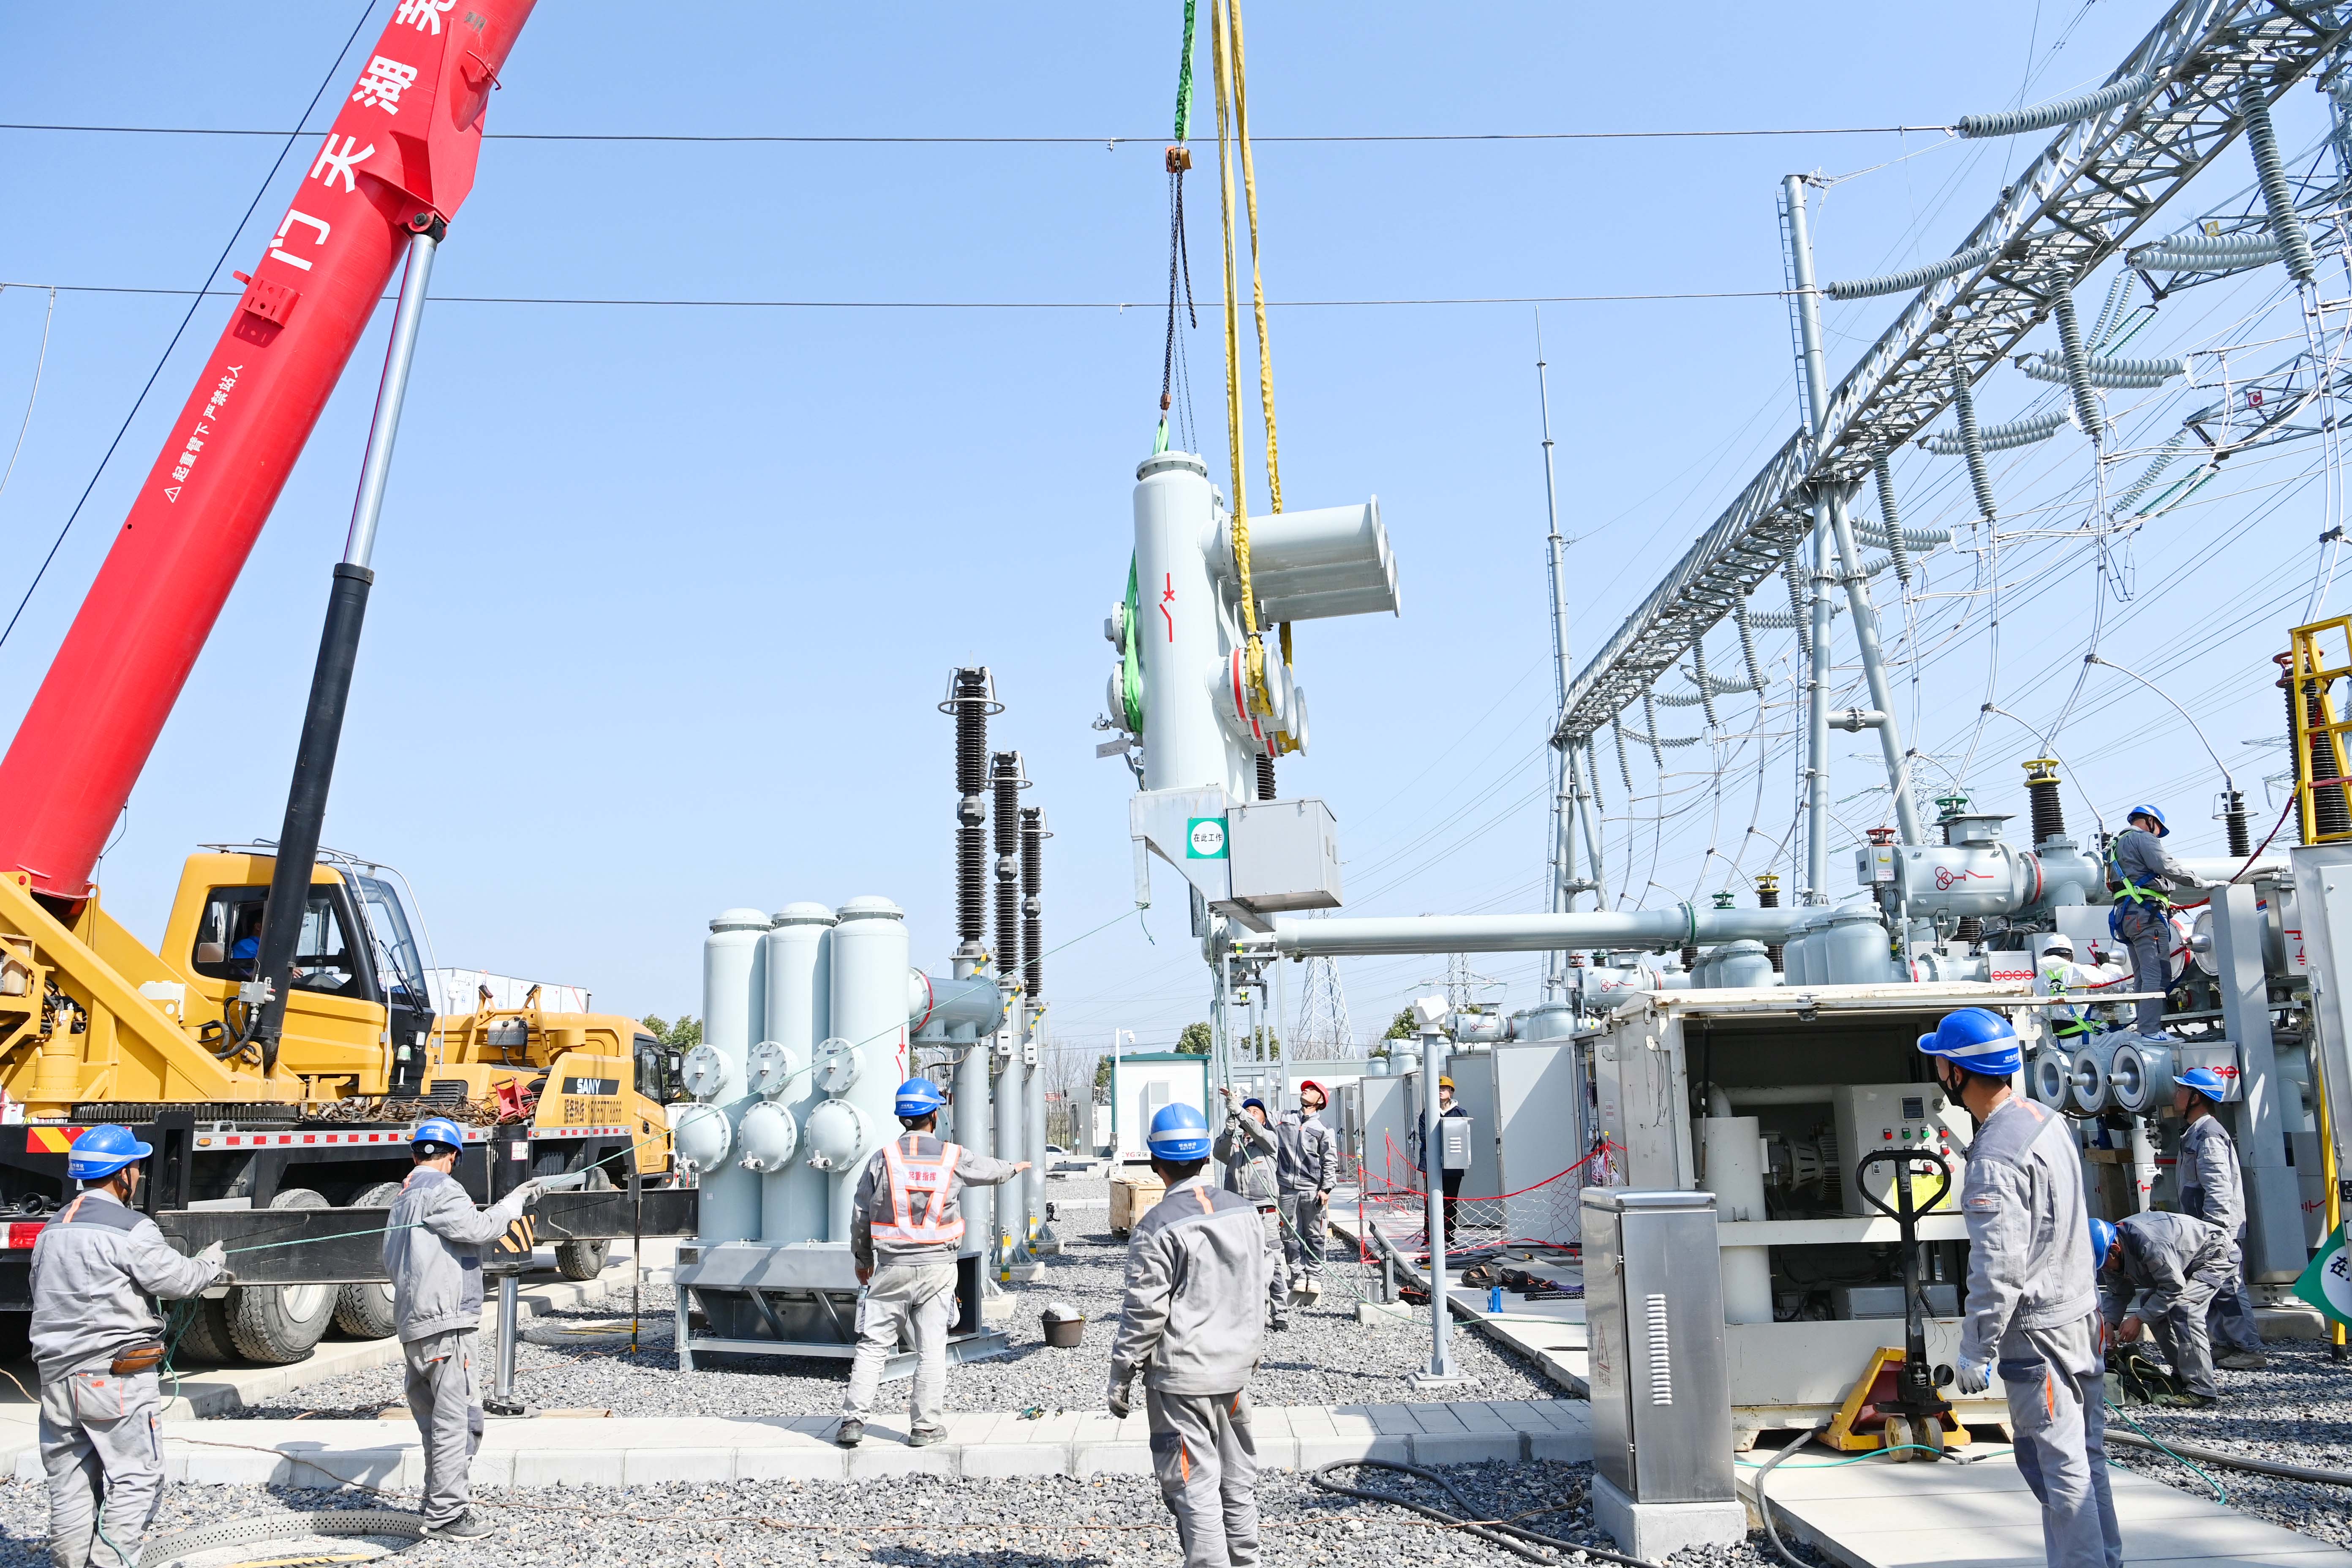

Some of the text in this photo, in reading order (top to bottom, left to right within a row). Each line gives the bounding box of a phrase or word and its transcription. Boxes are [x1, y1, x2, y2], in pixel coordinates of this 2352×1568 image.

[2207, 223, 2218, 236] A
[2250, 392, 2261, 405] C
[172, 364, 243, 482] 起重臂下 严禁站人
[1193, 833, 1222, 842] 在此工作
[577, 1078, 601, 1094] SANY
[909, 1171, 936, 1181] 起重指挥
